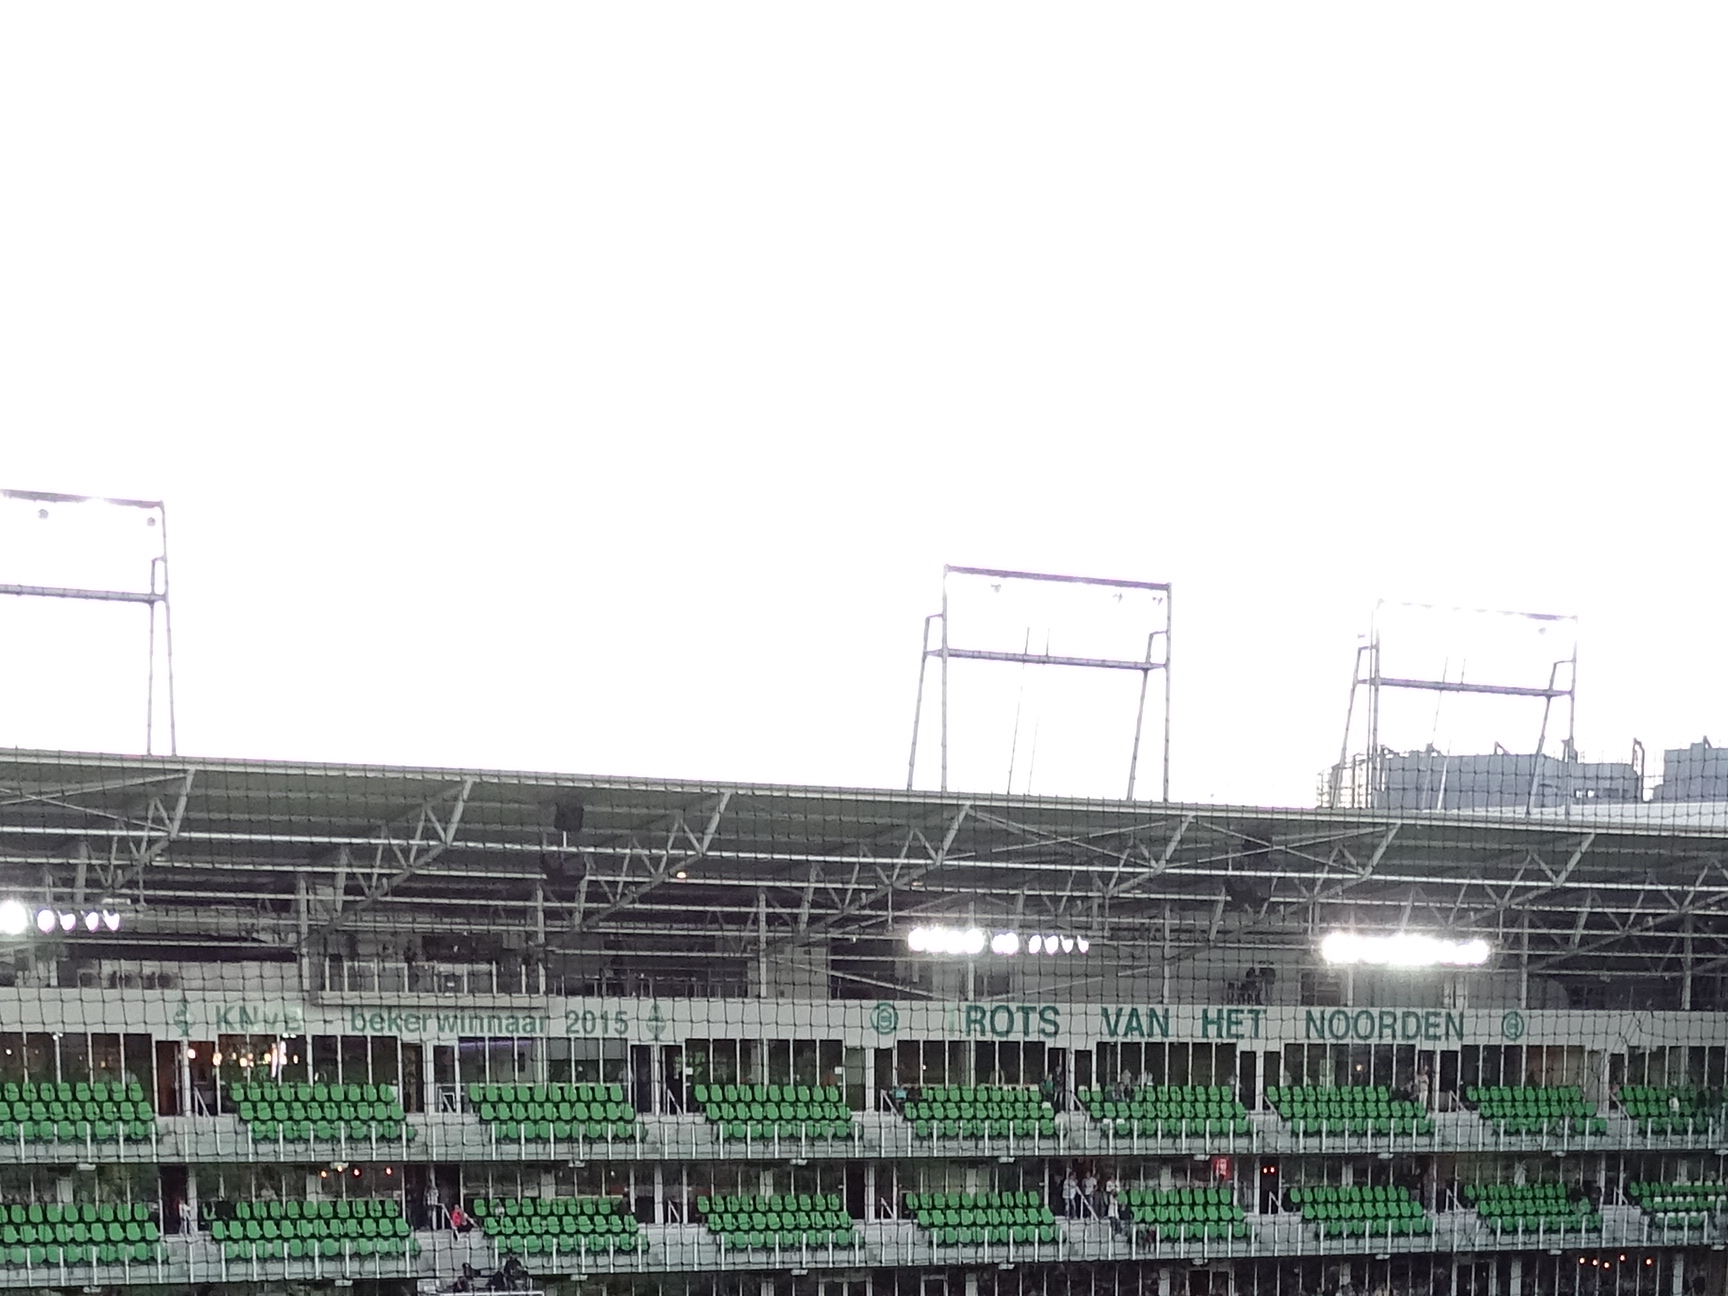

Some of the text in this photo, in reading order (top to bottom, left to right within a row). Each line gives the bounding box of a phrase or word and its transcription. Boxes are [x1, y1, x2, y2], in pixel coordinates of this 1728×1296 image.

[564, 1009, 630, 1036] 2015
[1101, 1006, 1170, 1039] VAN
[1201, 1007, 1263, 1039] HET
[1304, 1010, 1466, 1042] NOORDEN
